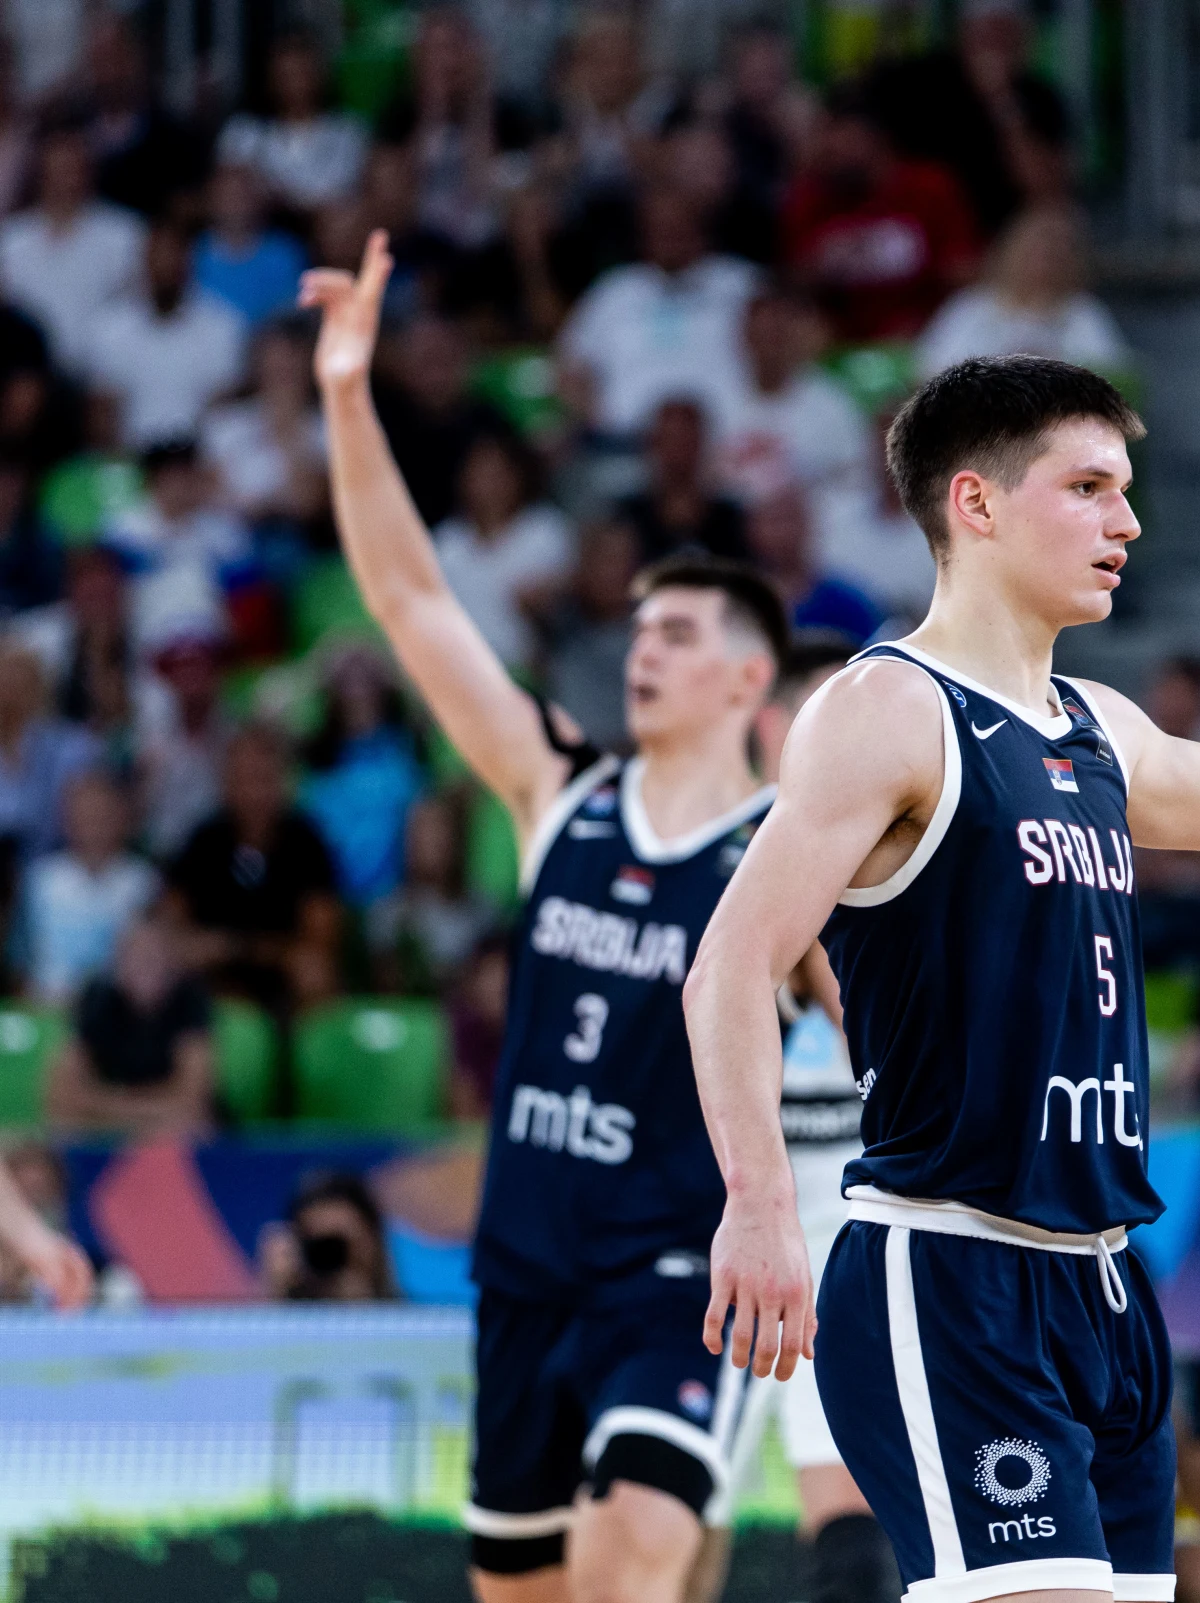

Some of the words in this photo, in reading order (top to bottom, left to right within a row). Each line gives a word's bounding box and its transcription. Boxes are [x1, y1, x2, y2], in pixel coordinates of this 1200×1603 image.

[533, 897, 687, 984] SRBIJA
[1094, 933, 1117, 1018] 5
[564, 994, 609, 1063] 3
[508, 1085, 637, 1165] mts
[1041, 1063, 1143, 1151] mt
[988, 1513, 1057, 1543] mts
